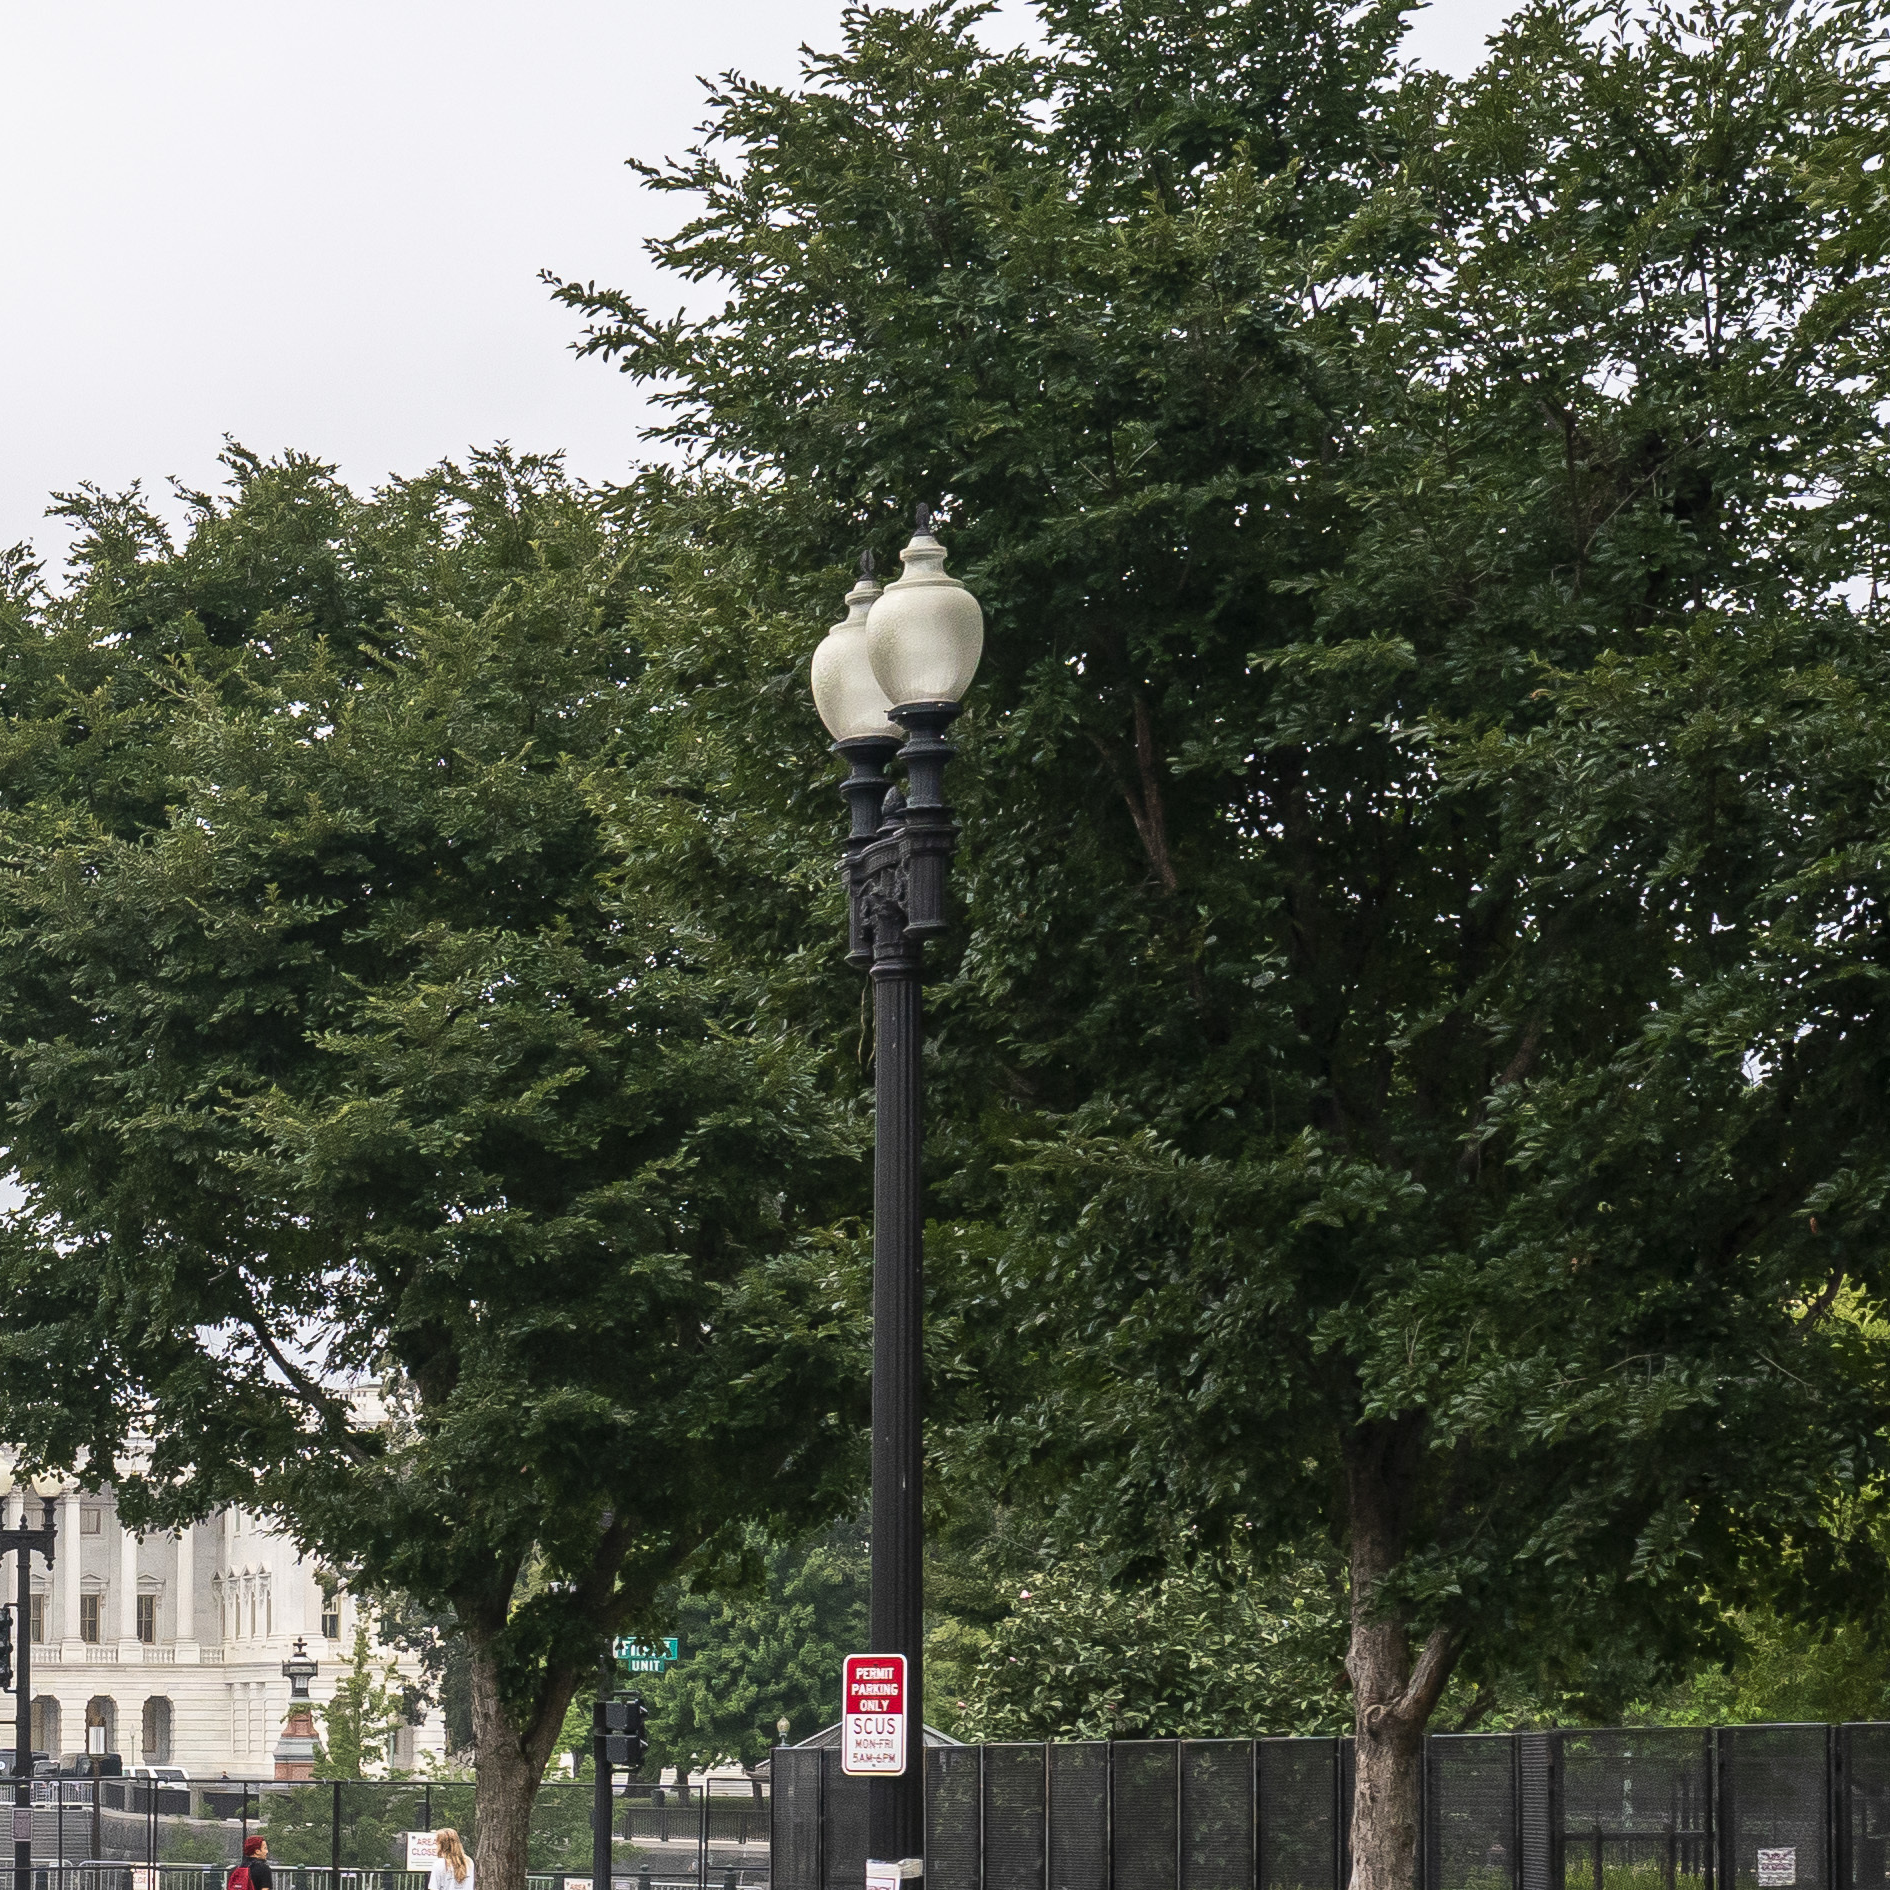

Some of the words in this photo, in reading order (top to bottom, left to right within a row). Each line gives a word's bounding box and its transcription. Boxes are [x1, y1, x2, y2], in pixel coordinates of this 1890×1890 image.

[631, 1660, 660, 1671] UNIT
[855, 1667, 895, 1680] PERMIT
[851, 1683, 899, 1695] PARKING
[859, 1699, 890, 1711] ONLY
[853, 1718, 896, 1734] SCUS
[411, 1847, 438, 1857] CLOSE
